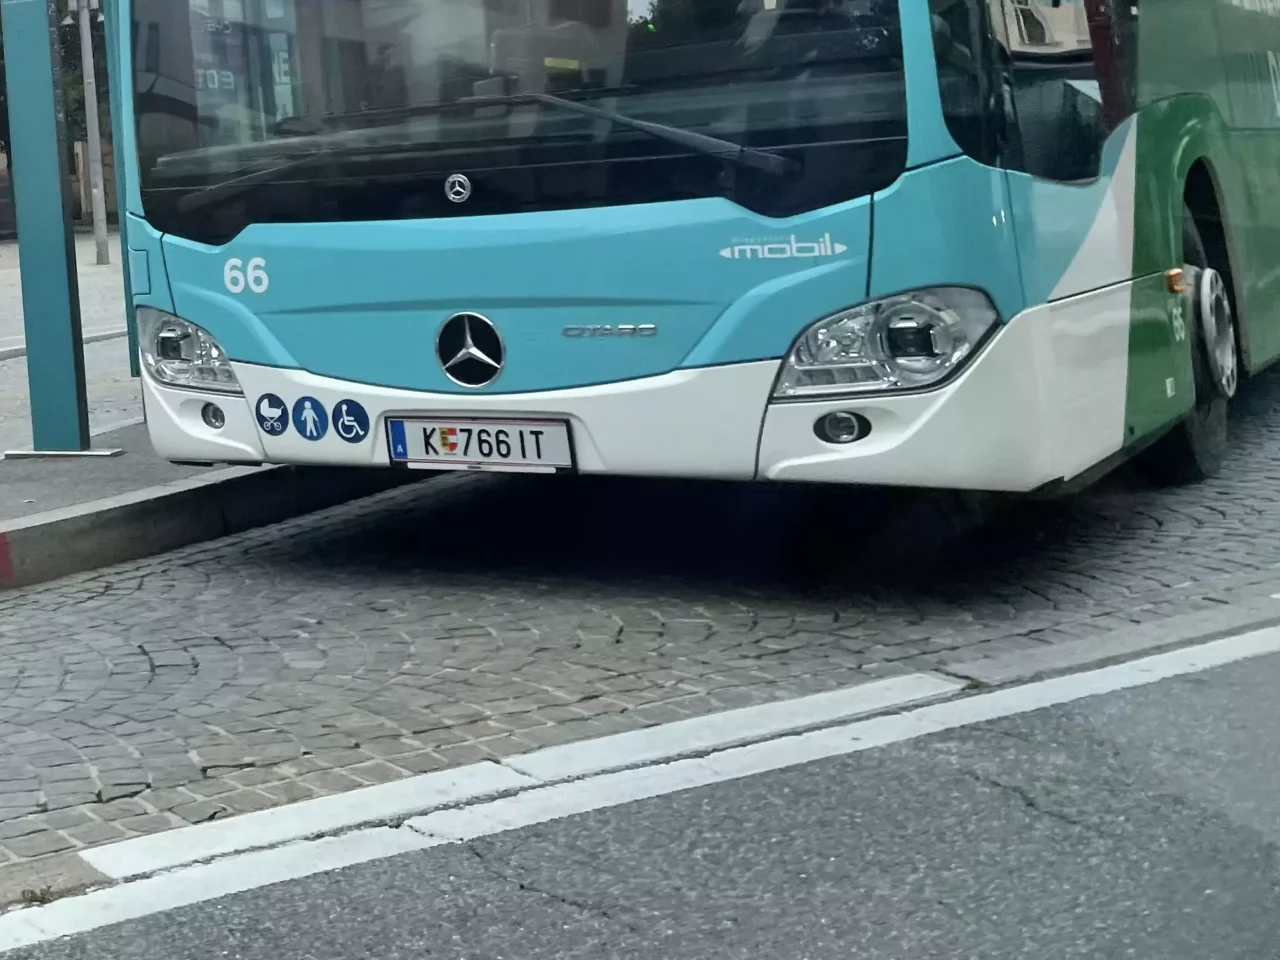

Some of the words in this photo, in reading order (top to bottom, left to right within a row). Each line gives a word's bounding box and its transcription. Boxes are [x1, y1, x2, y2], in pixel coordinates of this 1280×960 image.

[733, 232, 832, 259] mobil
[222, 256, 269, 294] 66
[397, 444, 404, 453] A
[422, 427, 439, 456] K
[459, 428, 512, 459] 766
[519, 429, 545, 459] IT
